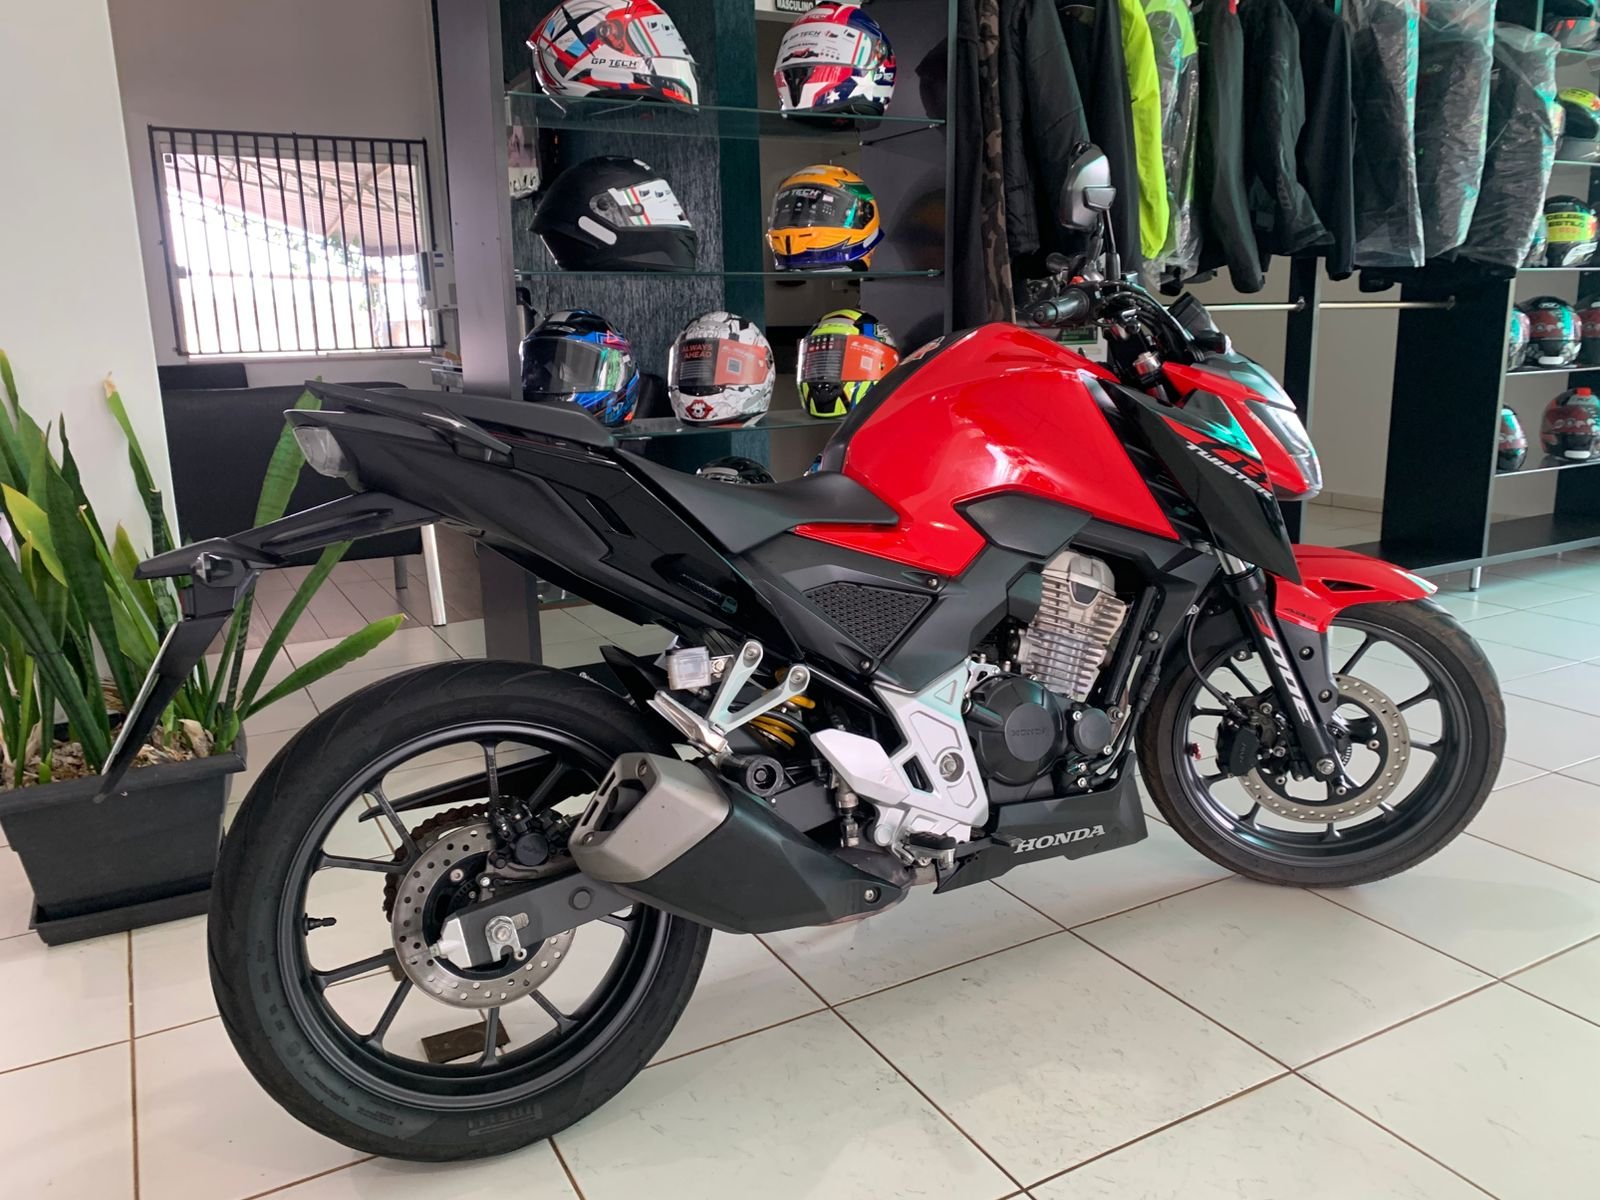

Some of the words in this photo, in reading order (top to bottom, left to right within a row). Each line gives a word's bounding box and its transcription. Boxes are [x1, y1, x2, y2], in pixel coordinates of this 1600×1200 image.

[591, 57, 606, 65] GP
[609, 57, 638, 69] TECH
[791, 188, 820, 198] TECH
[1186, 441, 1274, 501] TWISTER
[1014, 824, 1106, 854] HONDA
